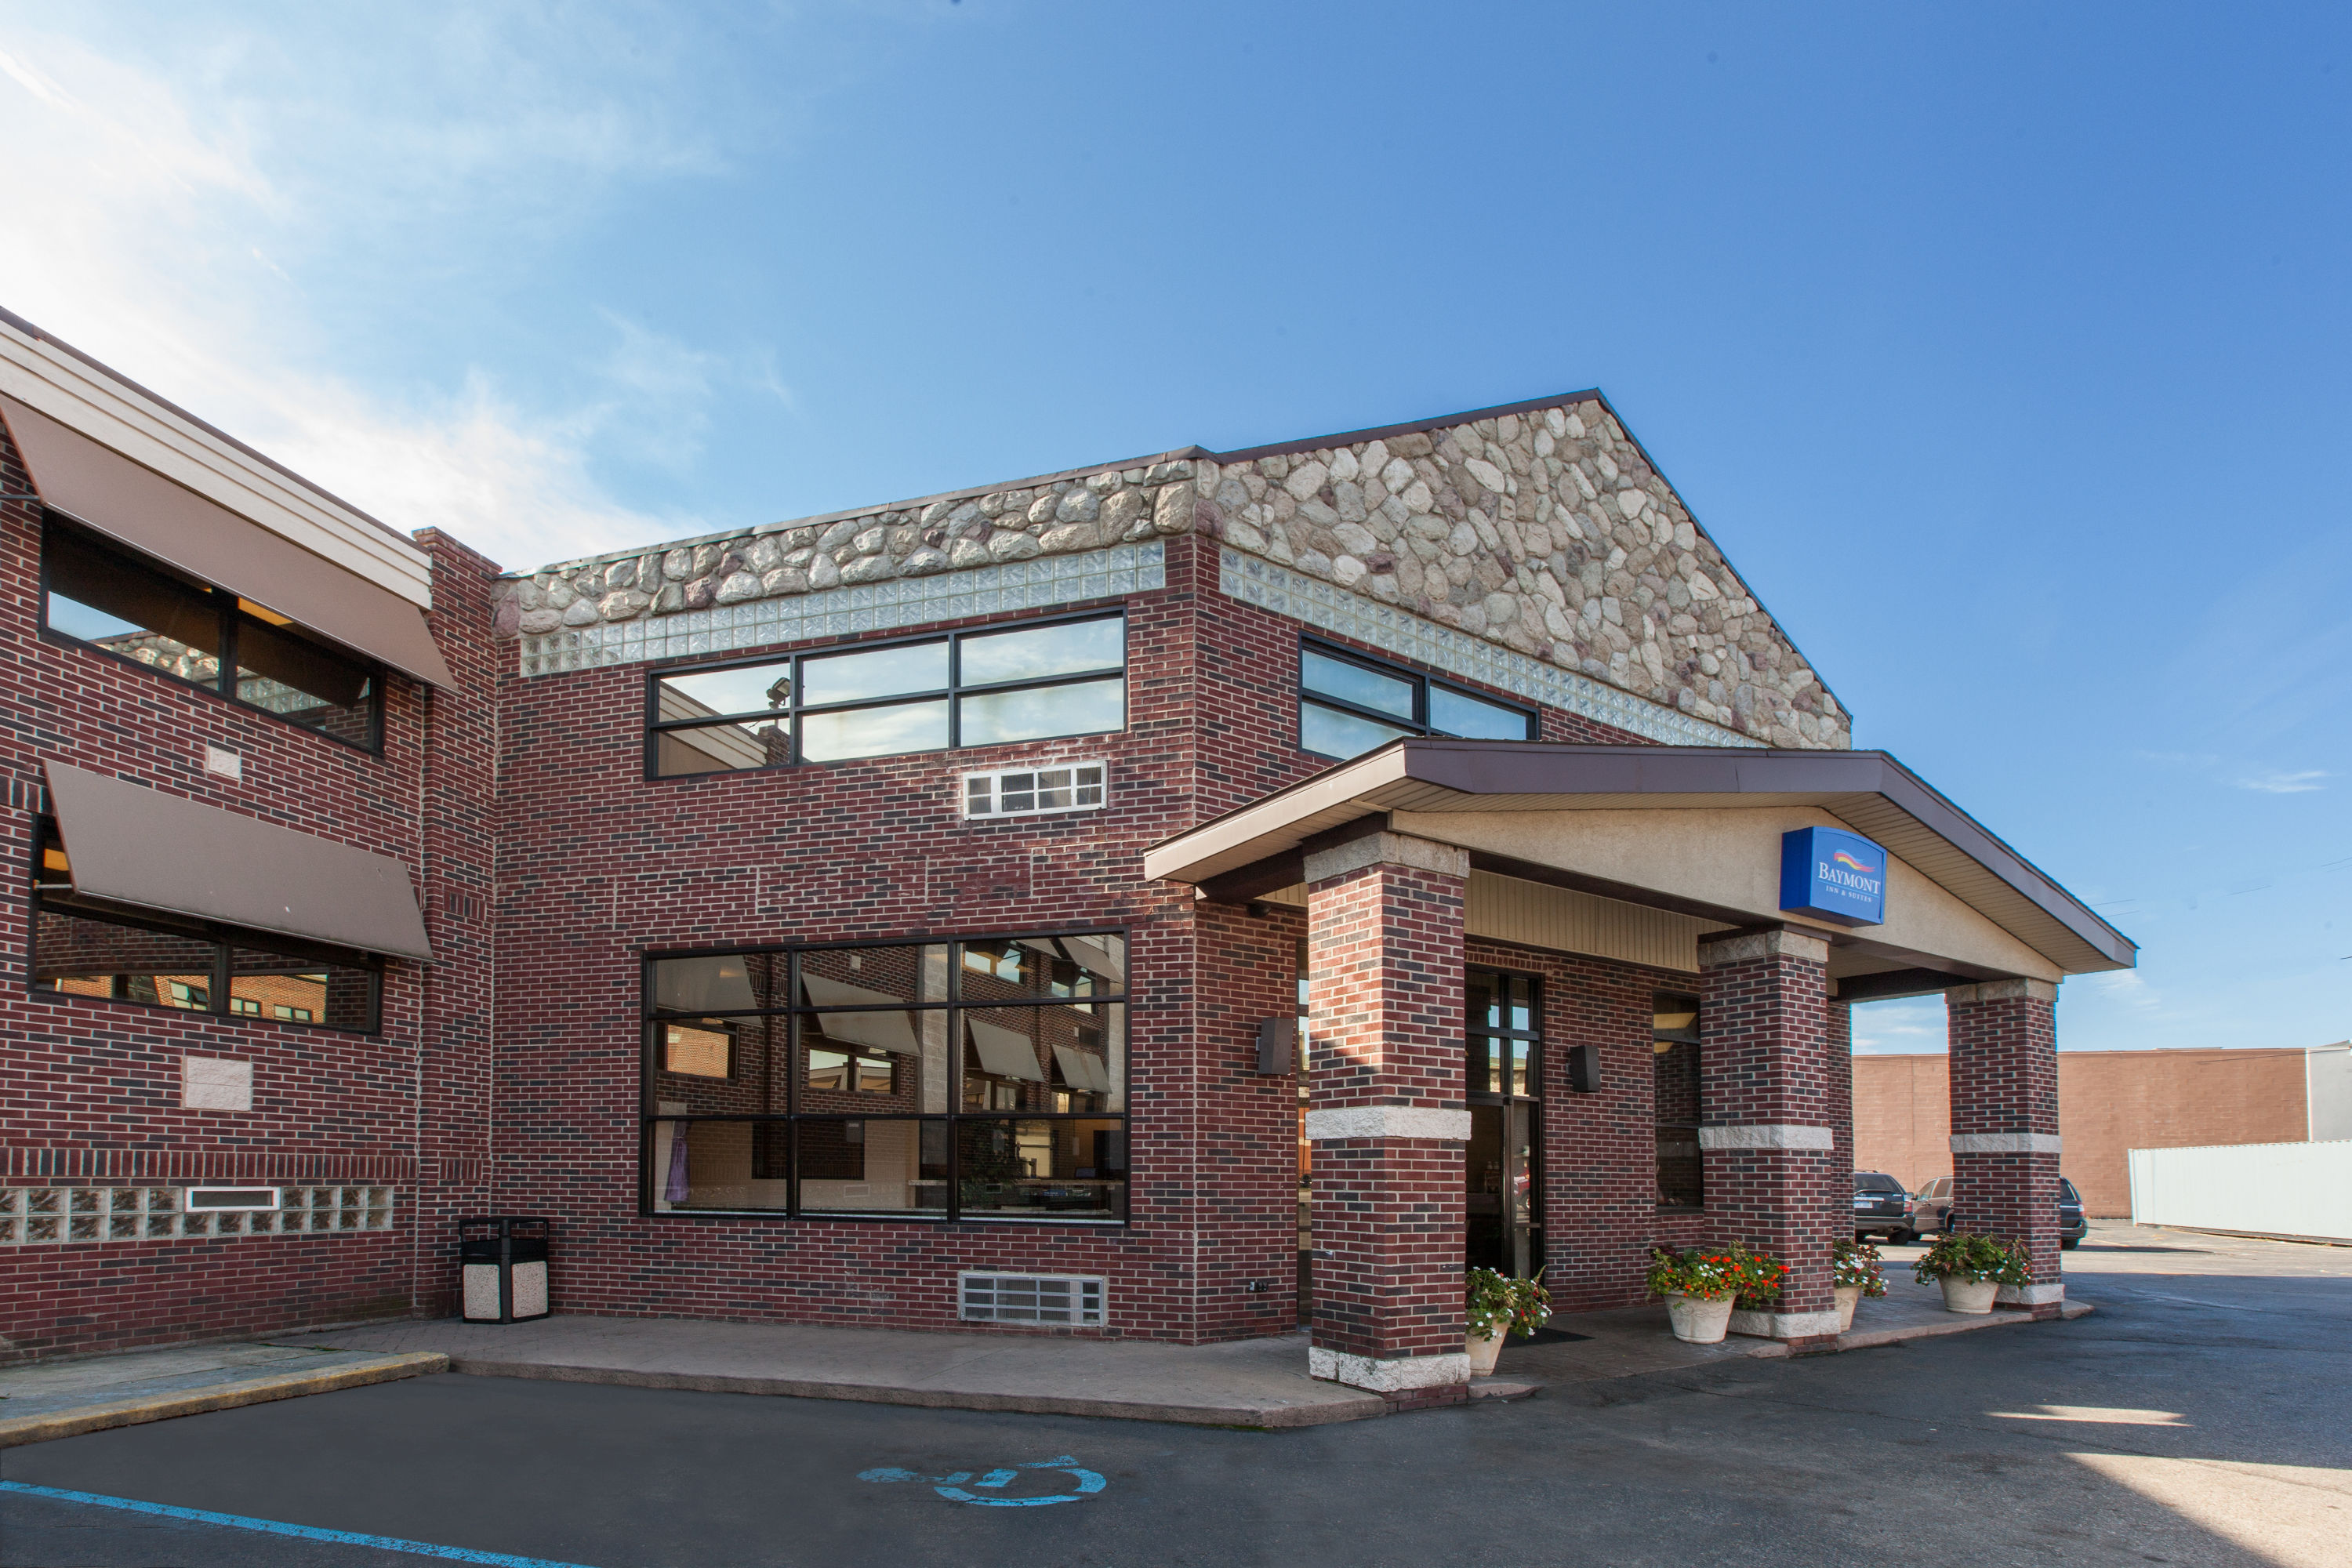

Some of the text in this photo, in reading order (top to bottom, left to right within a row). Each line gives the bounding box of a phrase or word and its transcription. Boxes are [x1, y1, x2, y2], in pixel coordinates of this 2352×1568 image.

[1818, 862, 1881, 894] BAYMONT
[1826, 885, 1838, 894] INN
[1848, 891, 1872, 902] SUITES
